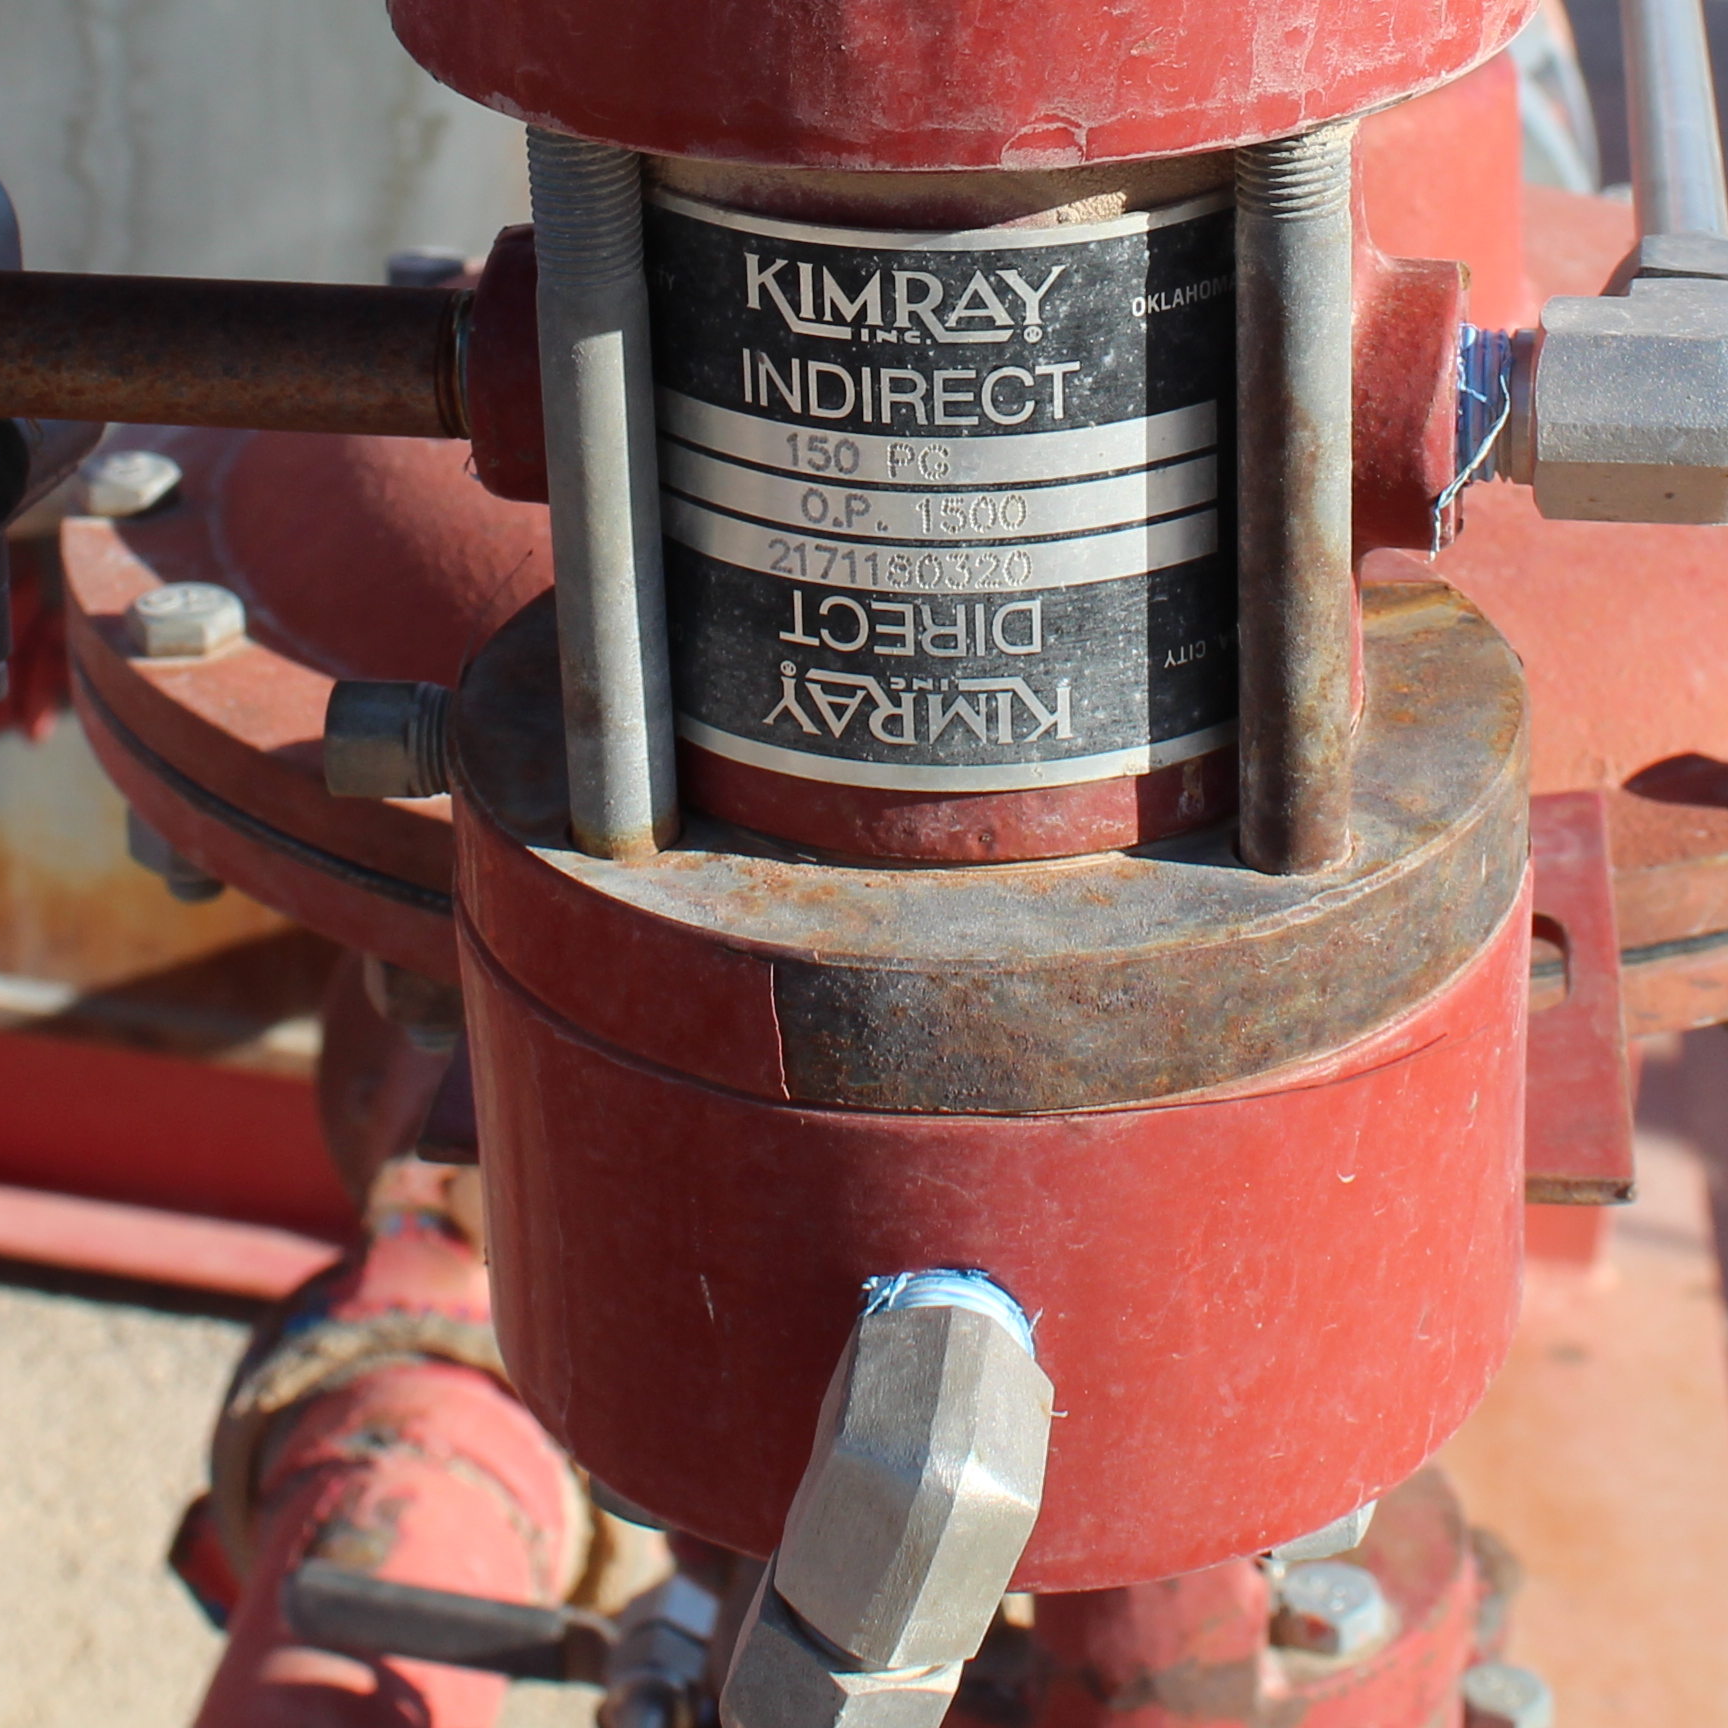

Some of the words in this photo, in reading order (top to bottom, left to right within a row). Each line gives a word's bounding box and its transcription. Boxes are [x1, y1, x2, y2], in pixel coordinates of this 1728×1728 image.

[743, 251, 1068, 344] KIMRAY
[860, 326, 932, 346] INC.
[742, 347, 1081, 426] INDIRECT
[786, 431, 861, 476] 150
[887, 441, 950, 480] PG
[915, 493, 1028, 535] 1500
[767, 537, 1033, 591] 2171180320
[778, 589, 1043, 658] DIRECT
[1163, 639, 1207, 669] CITY
[761, 665, 1075, 746] KIMRAY
